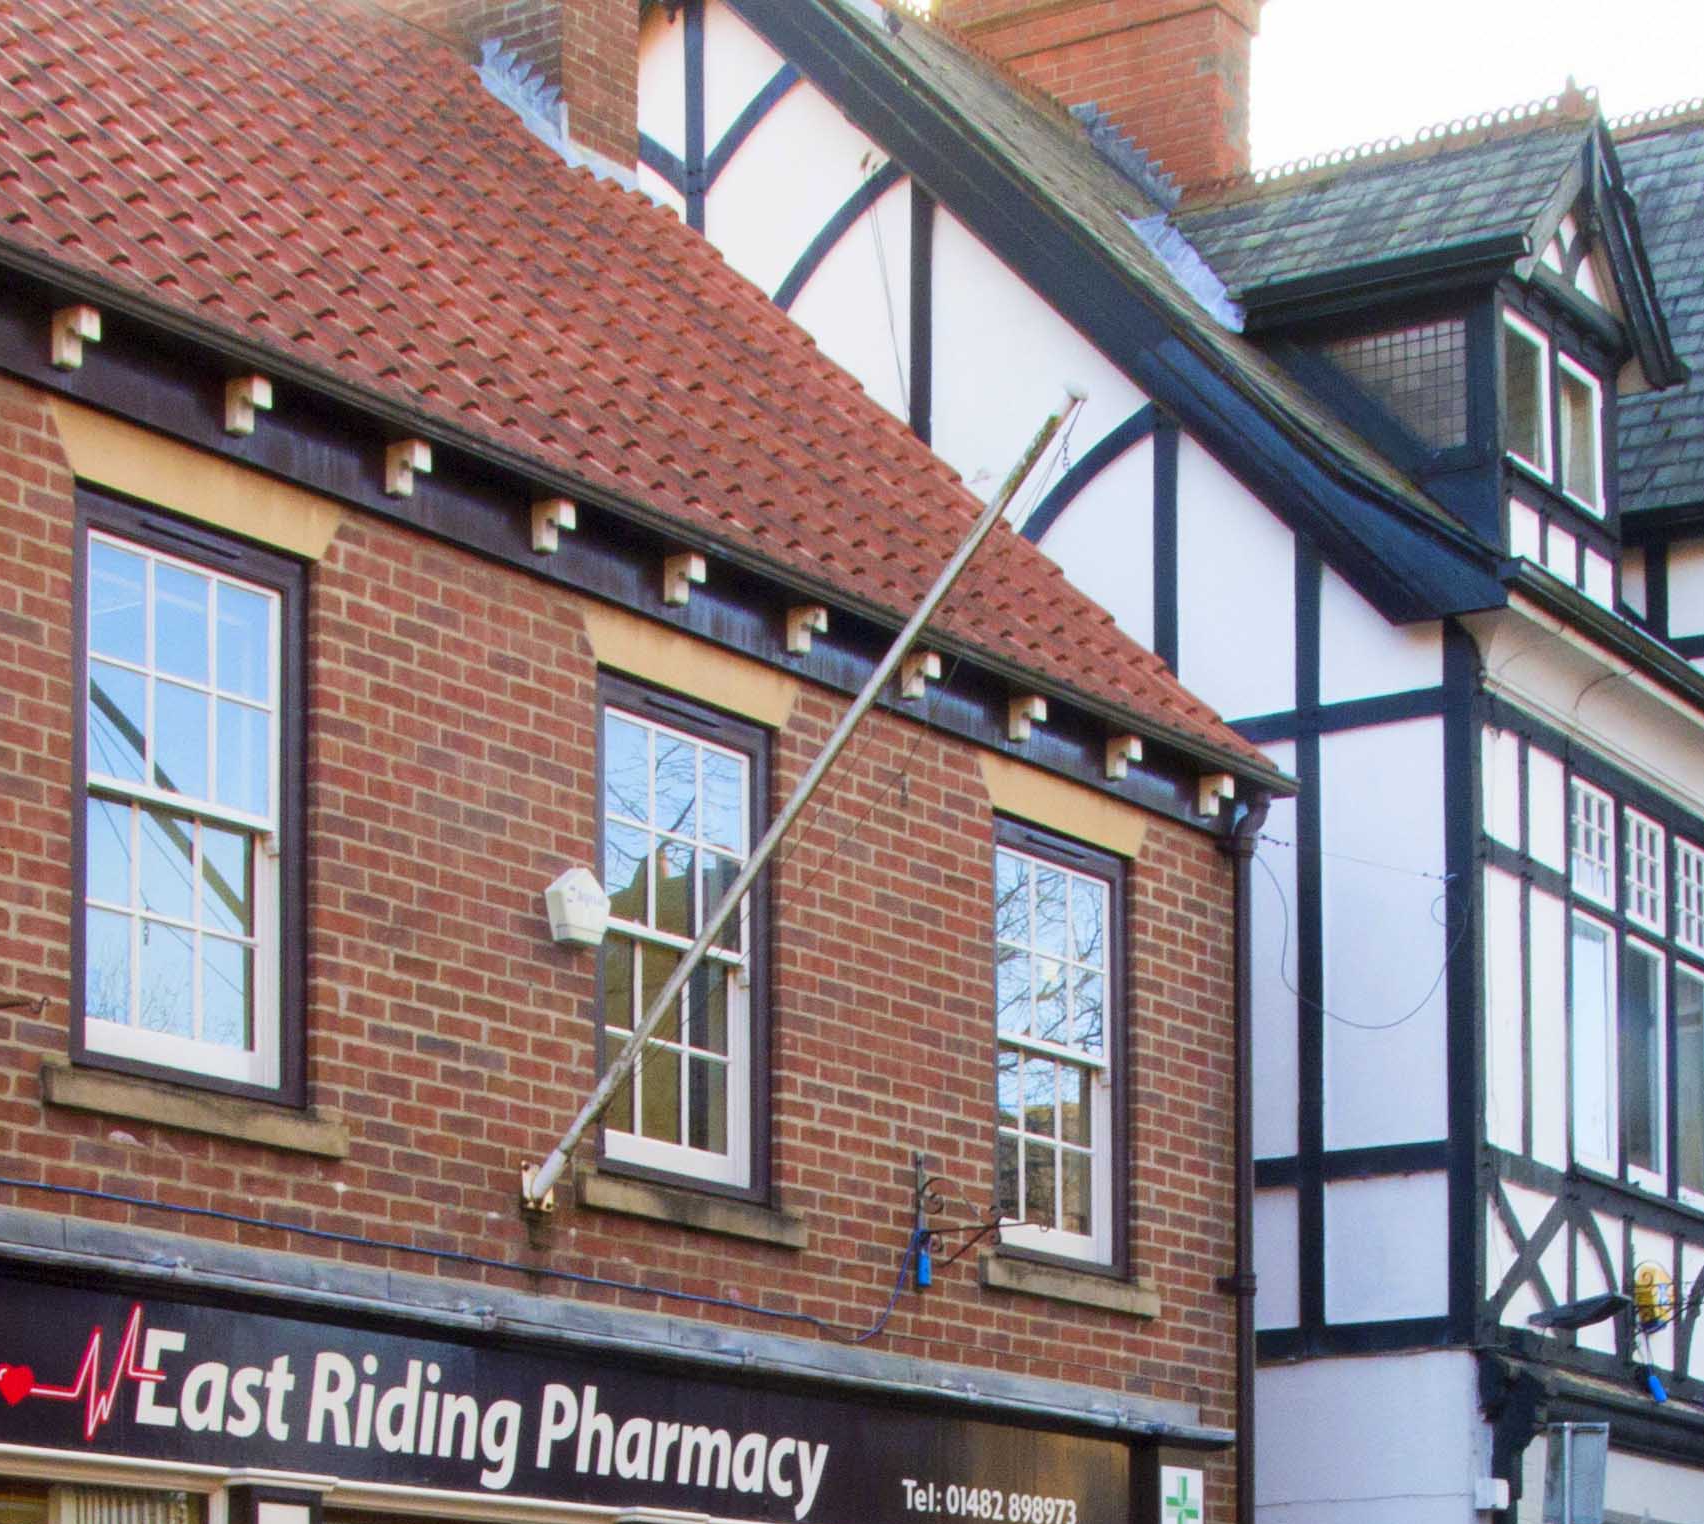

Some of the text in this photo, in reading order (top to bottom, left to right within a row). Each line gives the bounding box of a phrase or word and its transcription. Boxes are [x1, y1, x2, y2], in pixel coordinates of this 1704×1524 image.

[134, 1328, 829, 1521] East Riding Pharmacy
[901, 1478, 942, 1513] Tel:
[946, 1484, 1004, 1522] 01482
